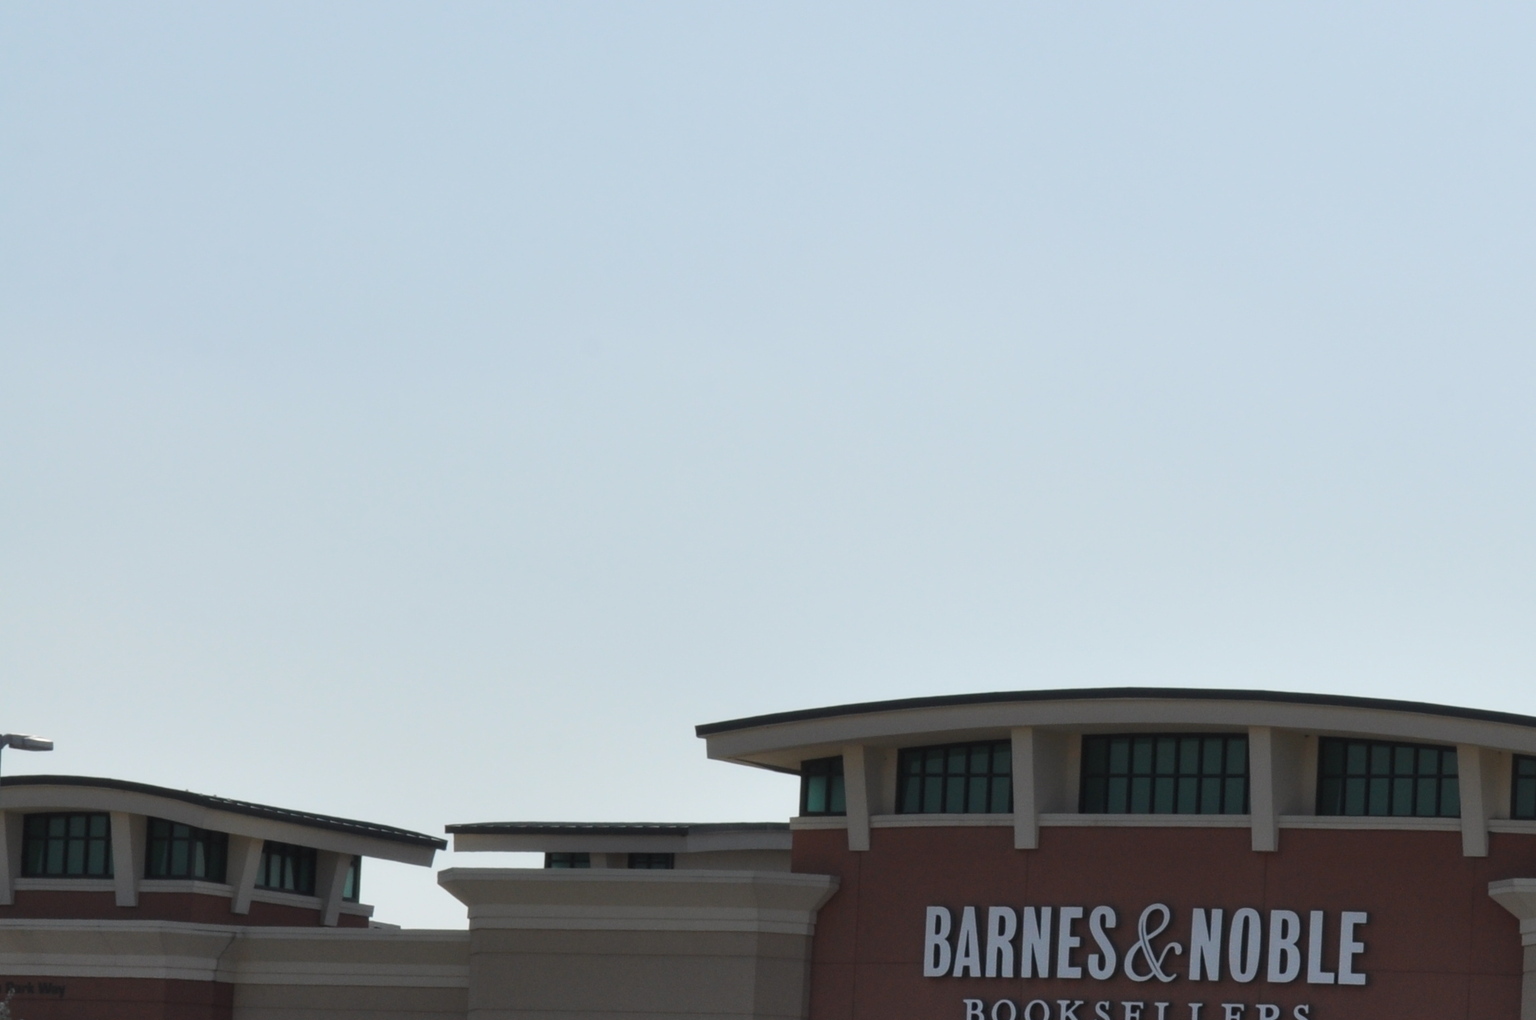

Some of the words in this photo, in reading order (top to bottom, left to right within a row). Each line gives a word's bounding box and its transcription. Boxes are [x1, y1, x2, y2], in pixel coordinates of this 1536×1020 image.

[923, 904, 1117, 980] BARNES
[1124, 903, 1182, 982] &
[1188, 907, 1368, 985] NOBLE
[38, 982, 66, 999] Way
